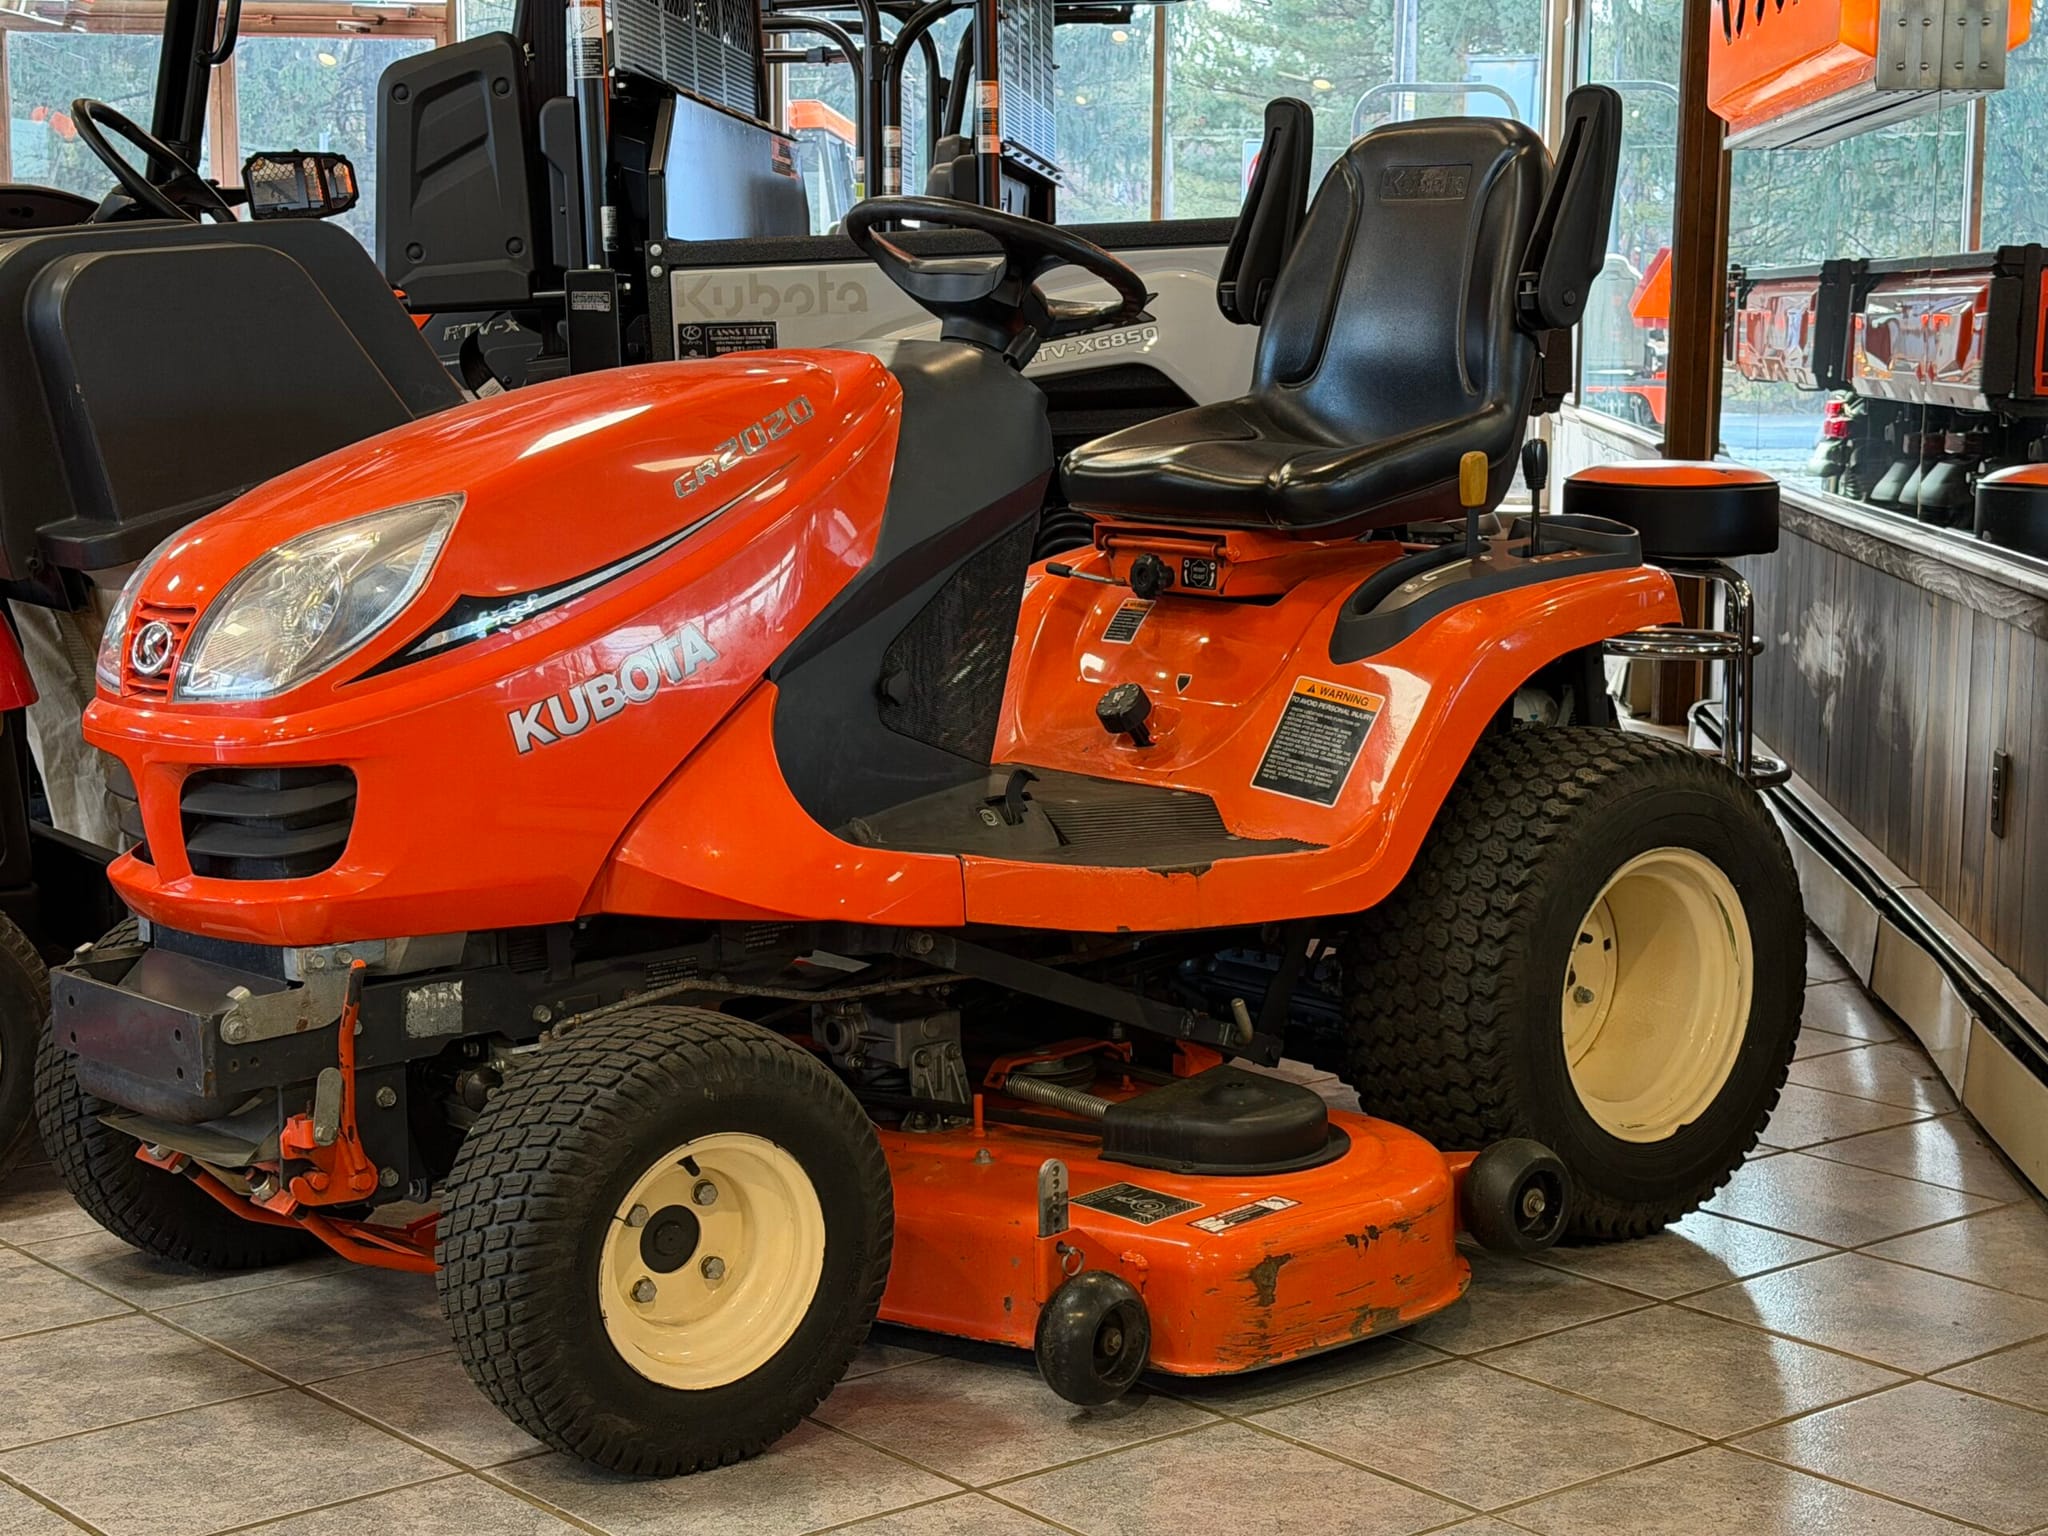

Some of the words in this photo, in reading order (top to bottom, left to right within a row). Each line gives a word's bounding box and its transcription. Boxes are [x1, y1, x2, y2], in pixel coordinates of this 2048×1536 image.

[676, 270, 868, 318] Kubota
[673, 394, 815, 498] GR2020
[508, 622, 719, 754] KUBOTA
[1319, 687, 1369, 707] WARNING
[1319, 702, 1351, 716] PERSONAL
